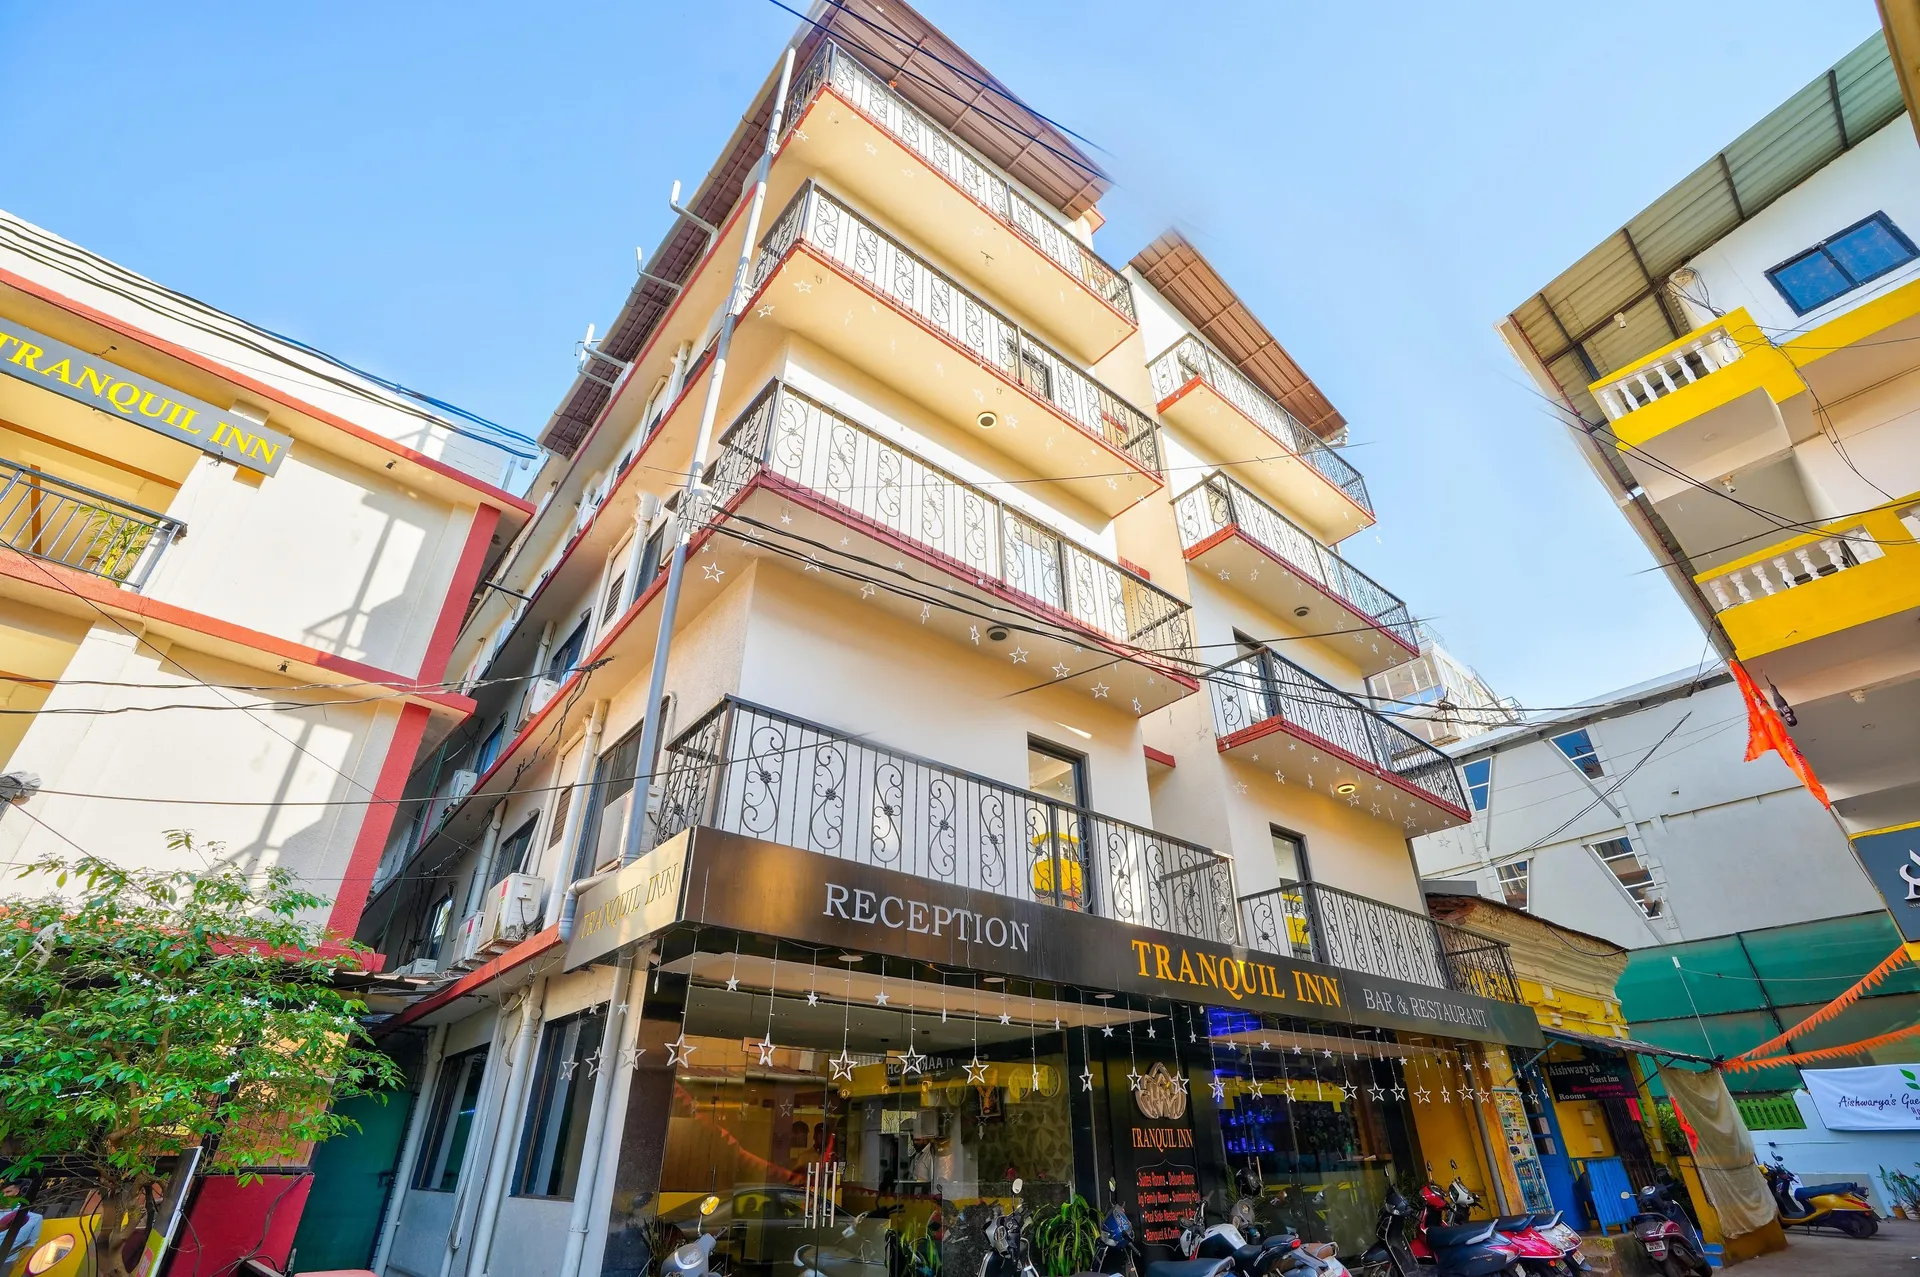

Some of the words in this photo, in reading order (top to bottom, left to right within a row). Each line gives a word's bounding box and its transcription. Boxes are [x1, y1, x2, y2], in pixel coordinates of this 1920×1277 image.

[0, 332, 201, 435] TRANQUIL
[207, 421, 281, 464] INN
[580, 884, 641, 939] TRANQUIL
[645, 862, 679, 905] INN
[823, 882, 1029, 952] RECEPTION
[1131, 940, 1285, 1000] TRANQUIL
[1291, 970, 1341, 1008] INN
[1363, 988, 1395, 1013] BAR
[1396, 994, 1409, 1015] &
[1409, 996, 1488, 1027] RESTAURANT
[1549, 1063, 1600, 1076] Aishwarya's
[1590, 1075, 1607, 1084] Guest
[1838, 1094, 1897, 1110] Aishwarya's
[1132, 1128, 1177, 1152] TRANQUIL
[1177, 1129, 1193, 1148] INN
[1144, 1191, 1158, 1206] Family
[1172, 1190, 1192, 1205] Swimming
[1144, 1210, 1154, 1223] Pool
[1154, 1209, 1163, 1222] Side
